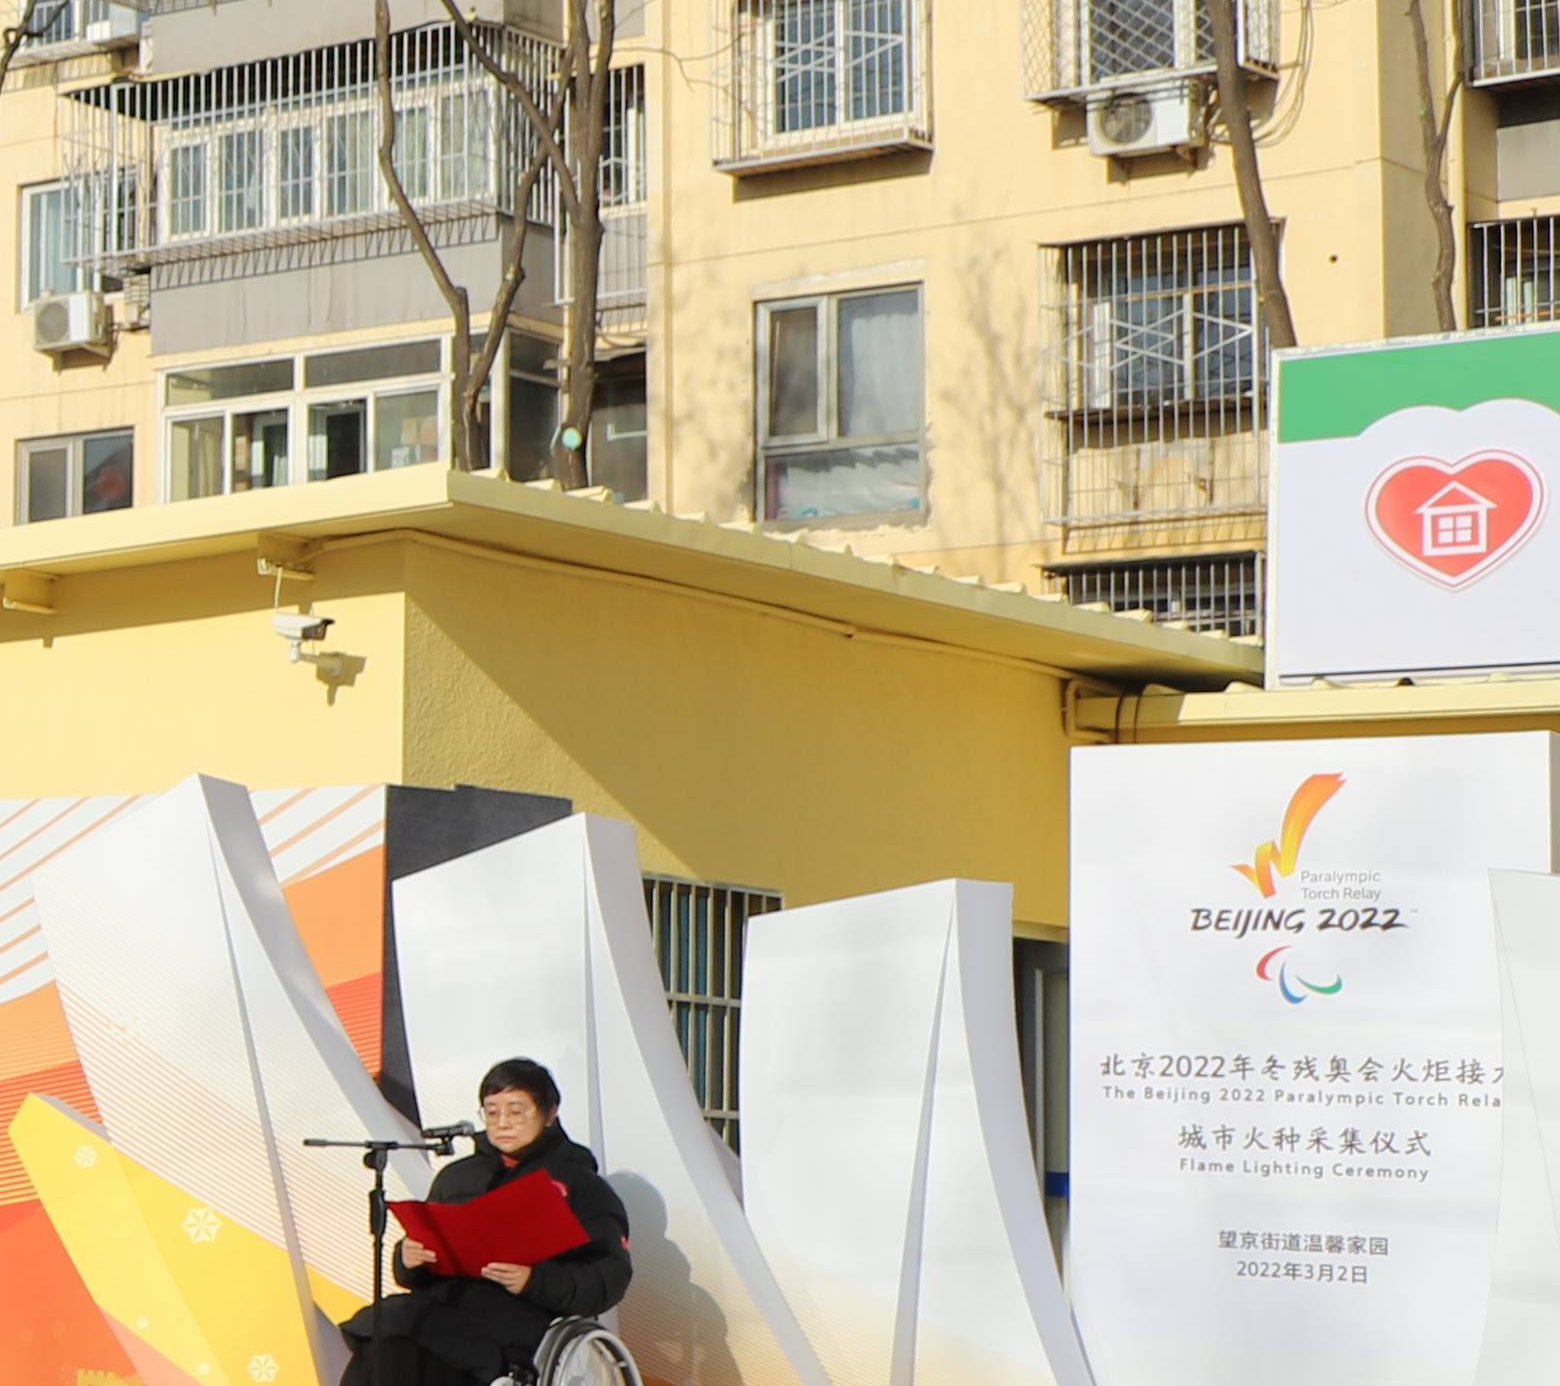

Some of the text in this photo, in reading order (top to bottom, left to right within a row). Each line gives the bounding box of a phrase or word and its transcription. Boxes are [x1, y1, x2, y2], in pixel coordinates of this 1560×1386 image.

[1300, 870, 1382, 887] Paralympic
[1300, 886, 1382, 903] Torch Relay
[1190, 906, 1410, 939] BEIJING 2022
[1102, 1085, 1502, 1108] The Beijing 2022 Paralympic Torch Rela
[1177, 1124, 1432, 1158] 城市火种采集仪式
[1179, 1158, 1429, 1182] Flame Lighting Ceremony
[1217, 1229, 1389, 1256] 望京街道温馨家园
[1236, 1260, 1368, 1284] 2022年3月2日
